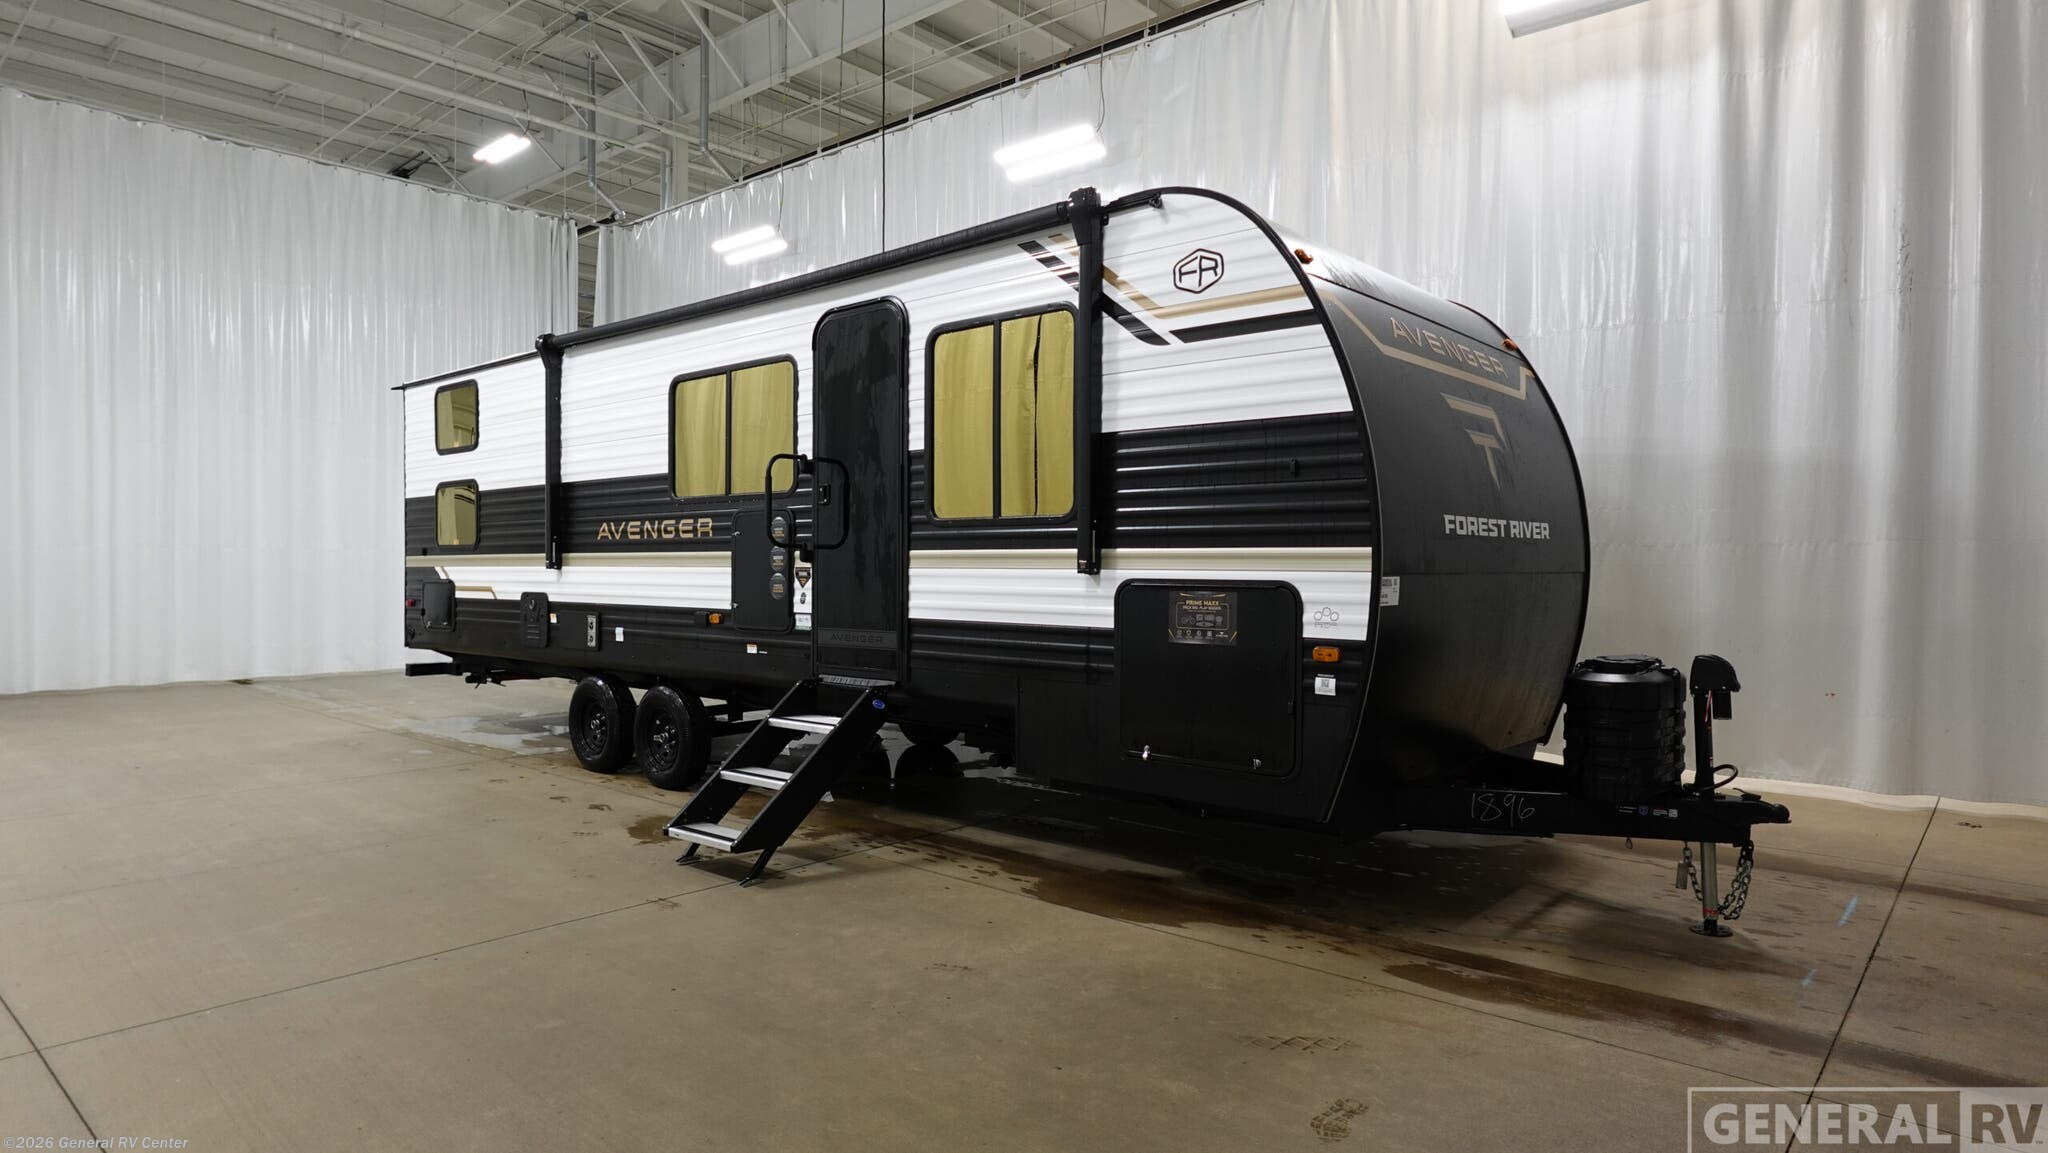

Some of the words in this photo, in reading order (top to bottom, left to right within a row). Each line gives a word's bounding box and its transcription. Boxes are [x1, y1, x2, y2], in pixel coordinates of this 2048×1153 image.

[1390, 316, 1509, 379] AVENGER
[597, 517, 713, 540] AVENGER
[1443, 514, 1507, 538] FOREST
[1509, 520, 1550, 539] RIVER
[830, 632, 885, 645] AVENGER
[1471, 792, 1536, 827] 1896
